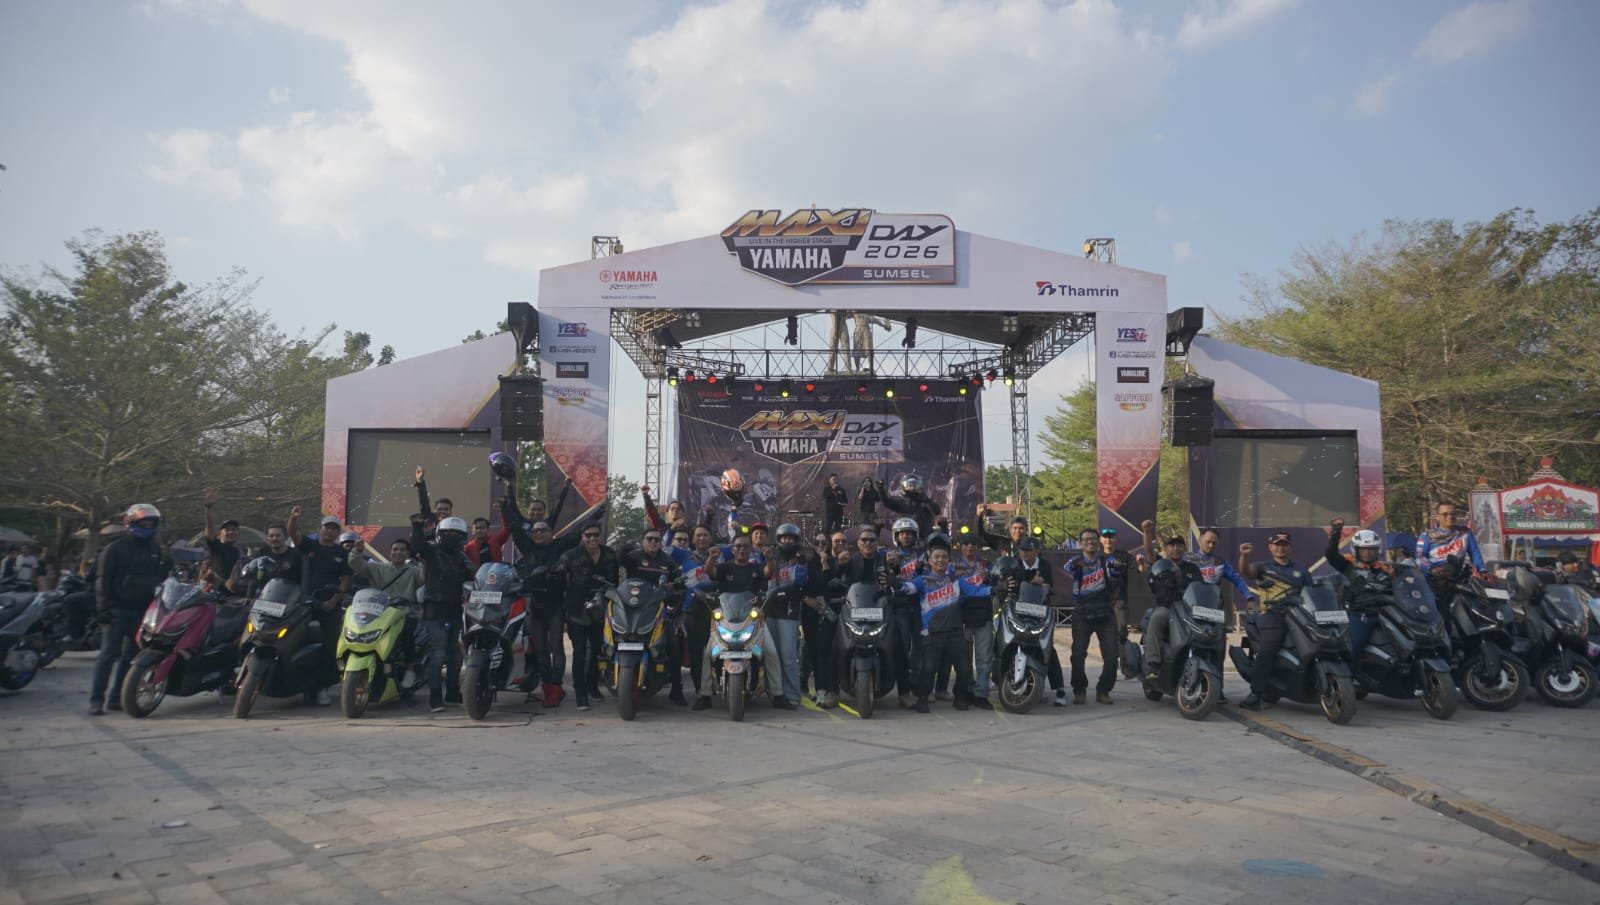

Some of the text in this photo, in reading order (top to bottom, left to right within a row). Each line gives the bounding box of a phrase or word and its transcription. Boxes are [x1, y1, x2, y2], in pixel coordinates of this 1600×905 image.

[721, 209, 872, 236] MAXI
[869, 225, 949, 241] DAY
[749, 248, 832, 269] YAMAHA
[864, 245, 939, 259] 2026
[613, 271, 657, 282] YAMAHA
[863, 269, 930, 279] SUMSEL
[1058, 284, 1119, 297] Thamrin
[1117, 327, 1137, 339] YES
[844, 421, 899, 434] DAY
[760, 438, 819, 454] YAMAHA
[841, 436, 892, 446] 2026
[927, 583, 954, 602] MRB
